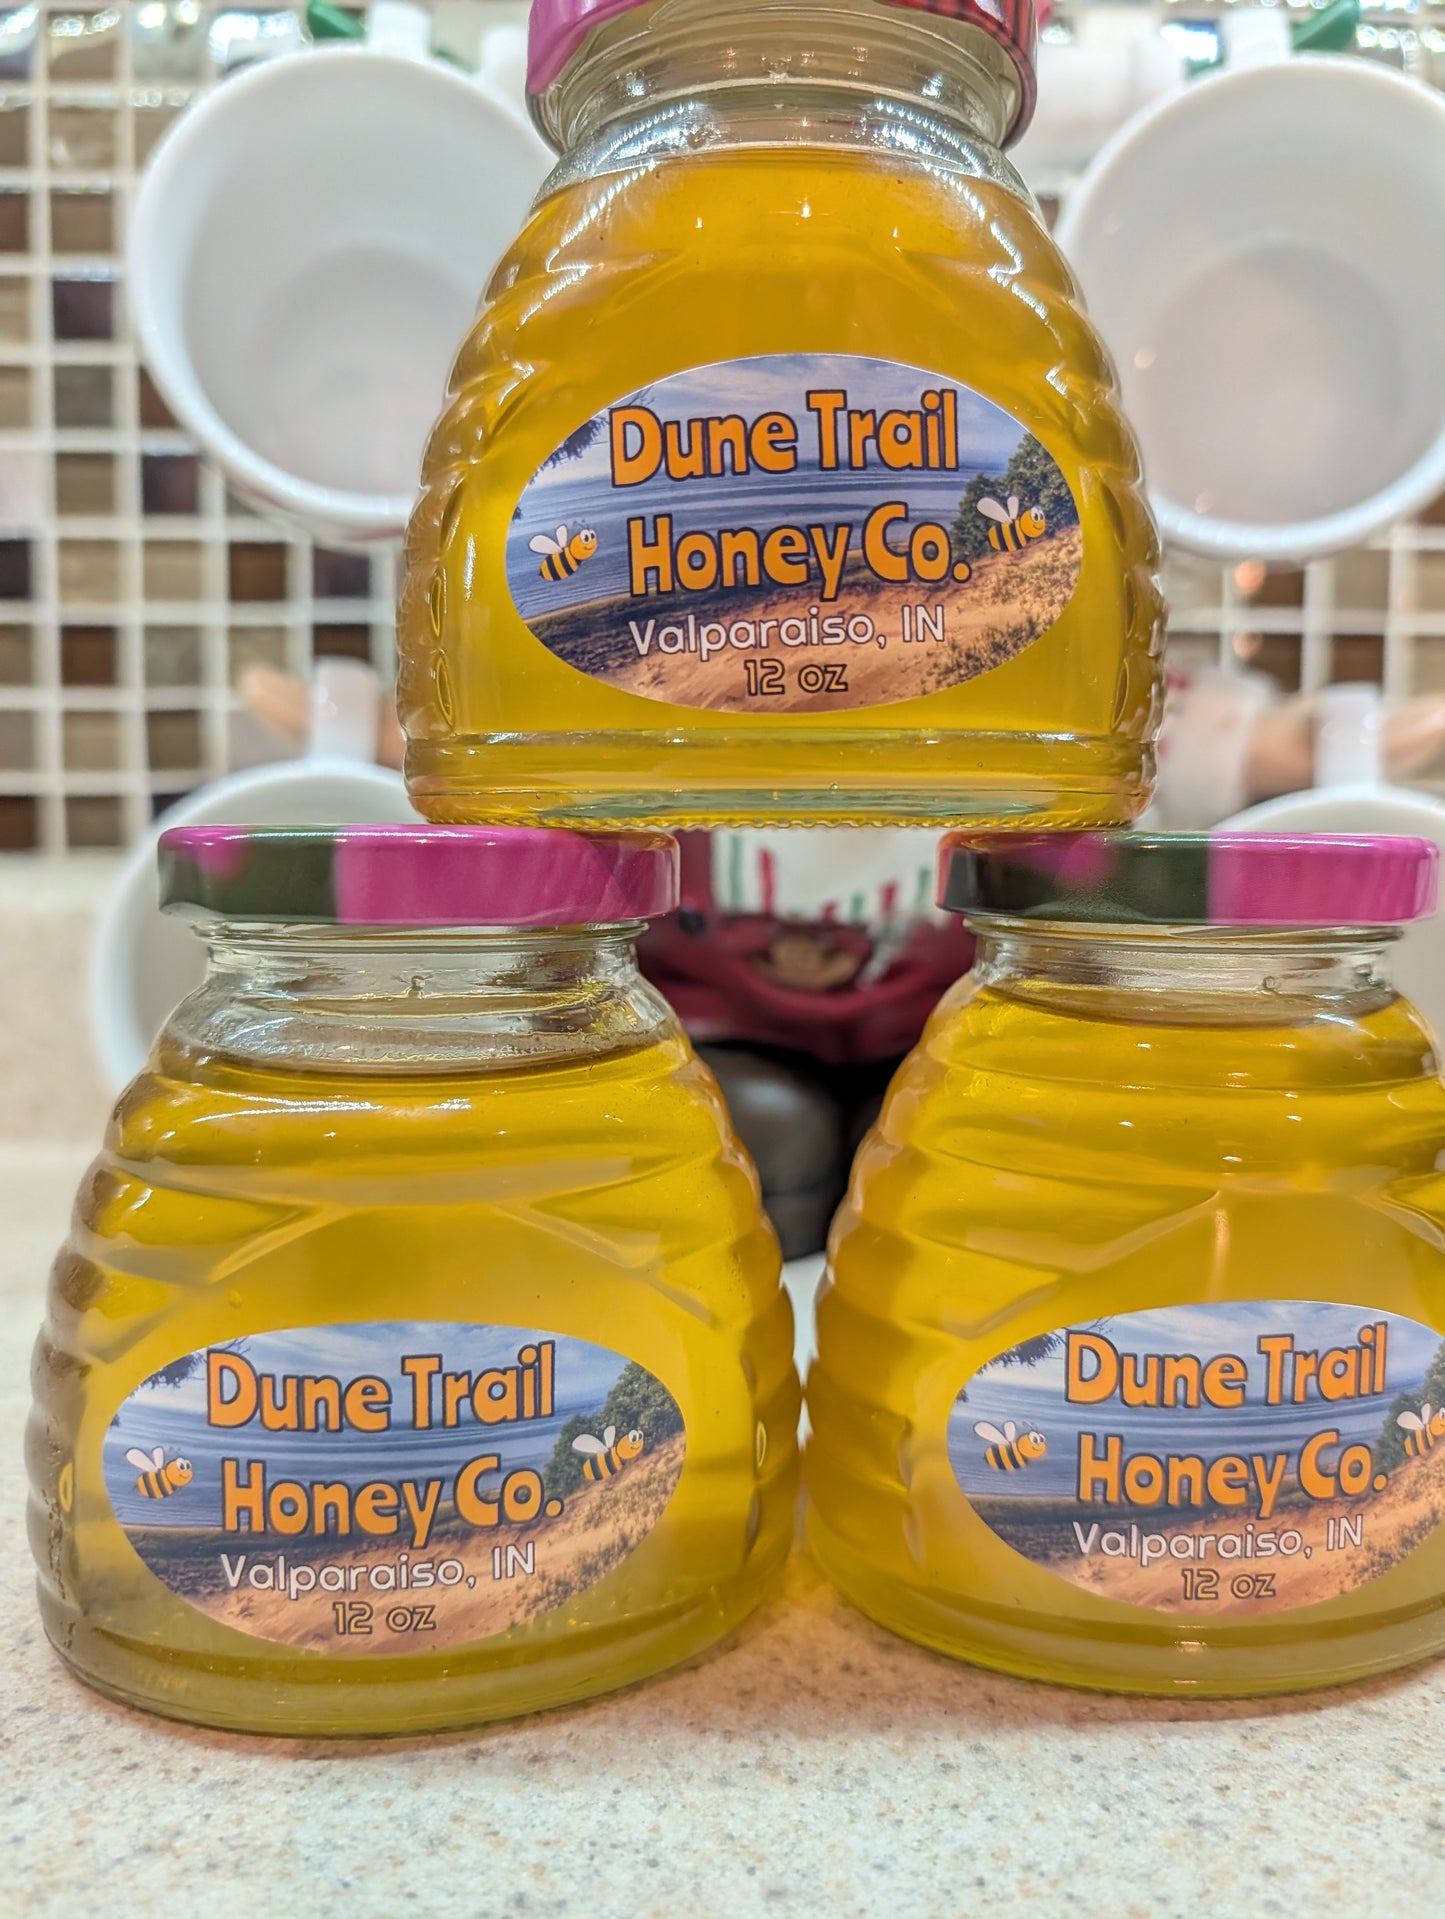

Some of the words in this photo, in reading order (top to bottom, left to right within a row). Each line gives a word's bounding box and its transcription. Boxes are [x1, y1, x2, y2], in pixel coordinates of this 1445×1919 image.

[609, 405, 798, 488] Dune
[806, 388, 959, 471] Trail
[627, 513, 851, 601] Honey
[863, 502, 972, 584] Co.
[628, 606, 887, 661] Valparaiso,
[901, 604, 945, 642] IN
[743, 659, 785, 696] 12
[798, 663, 848, 693] oz
[205, 1348, 393, 1433] Dune
[400, 1339, 556, 1431] Trail
[1065, 1330, 1248, 1409] Dune
[1257, 1321, 1389, 1406] Trail
[221, 1457, 442, 1549] Honey
[453, 1454, 565, 1528] Co.
[1077, 1431, 1288, 1520] Honey
[1299, 1428, 1389, 1501] Co.
[220, 1553, 476, 1600] Valparaiso,
[491, 1542, 536, 1579] IN
[1073, 1522, 1312, 1567] Valparaiso,
[1327, 1515, 1364, 1551] IN
[332, 1601, 373, 1636] 12
[385, 1604, 437, 1633] oz
[1181, 1568, 1219, 1600] 12
[1231, 1572, 1276, 1599] oz
